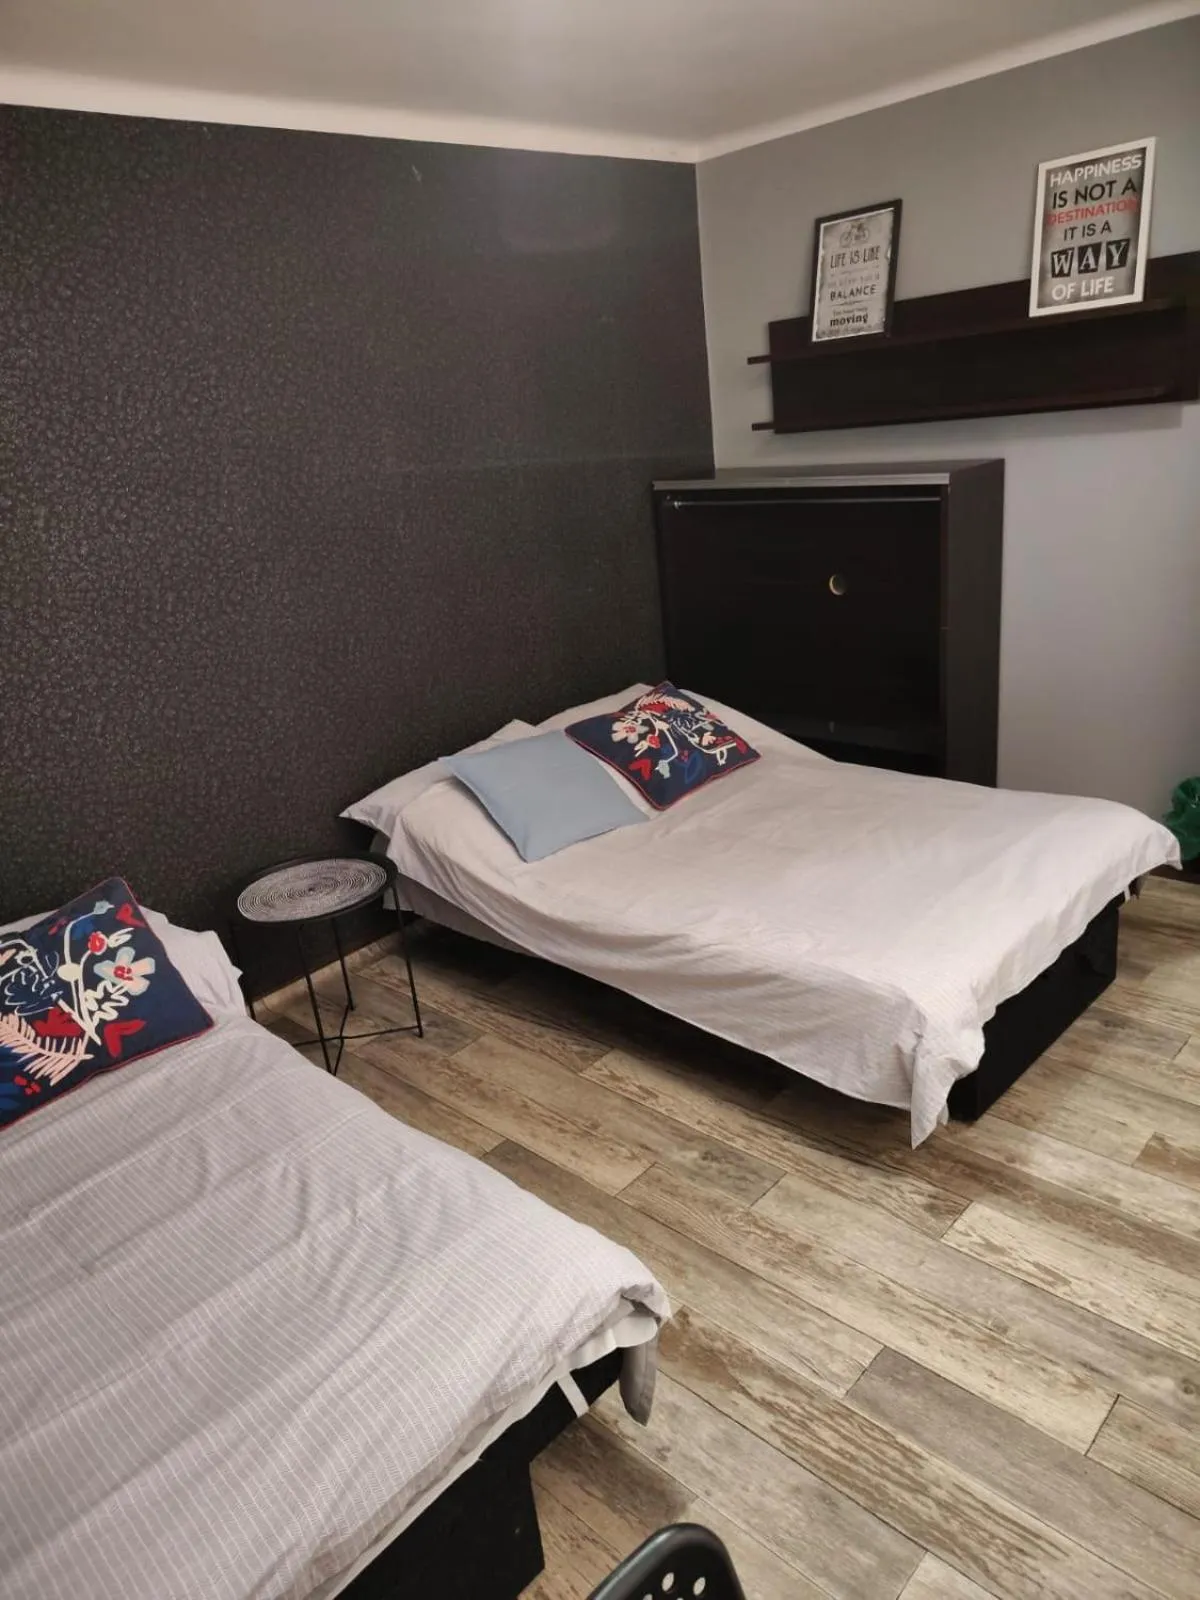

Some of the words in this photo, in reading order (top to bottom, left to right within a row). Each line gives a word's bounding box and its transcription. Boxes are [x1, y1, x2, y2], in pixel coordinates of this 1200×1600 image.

[1051, 155, 1142, 187] HAPPINESS
[1052, 191, 1068, 209] IS
[1074, 180, 1117, 205] NOT
[1121, 177, 1137, 195] A
[1047, 198, 1141, 226] DESTINATION
[1063, 226, 1078, 241] IT
[1081, 223, 1096, 238] IS
[1100, 220, 1112, 234] A
[830, 252, 846, 269] LIFE
[849, 250, 860, 265] IS
[1051, 240, 1129, 276] WAY
[830, 284, 876, 301] BALANCE
[1052, 283, 1076, 301] OF
[1081, 276, 1115, 297] LIFE
[830, 312, 869, 327] moving
